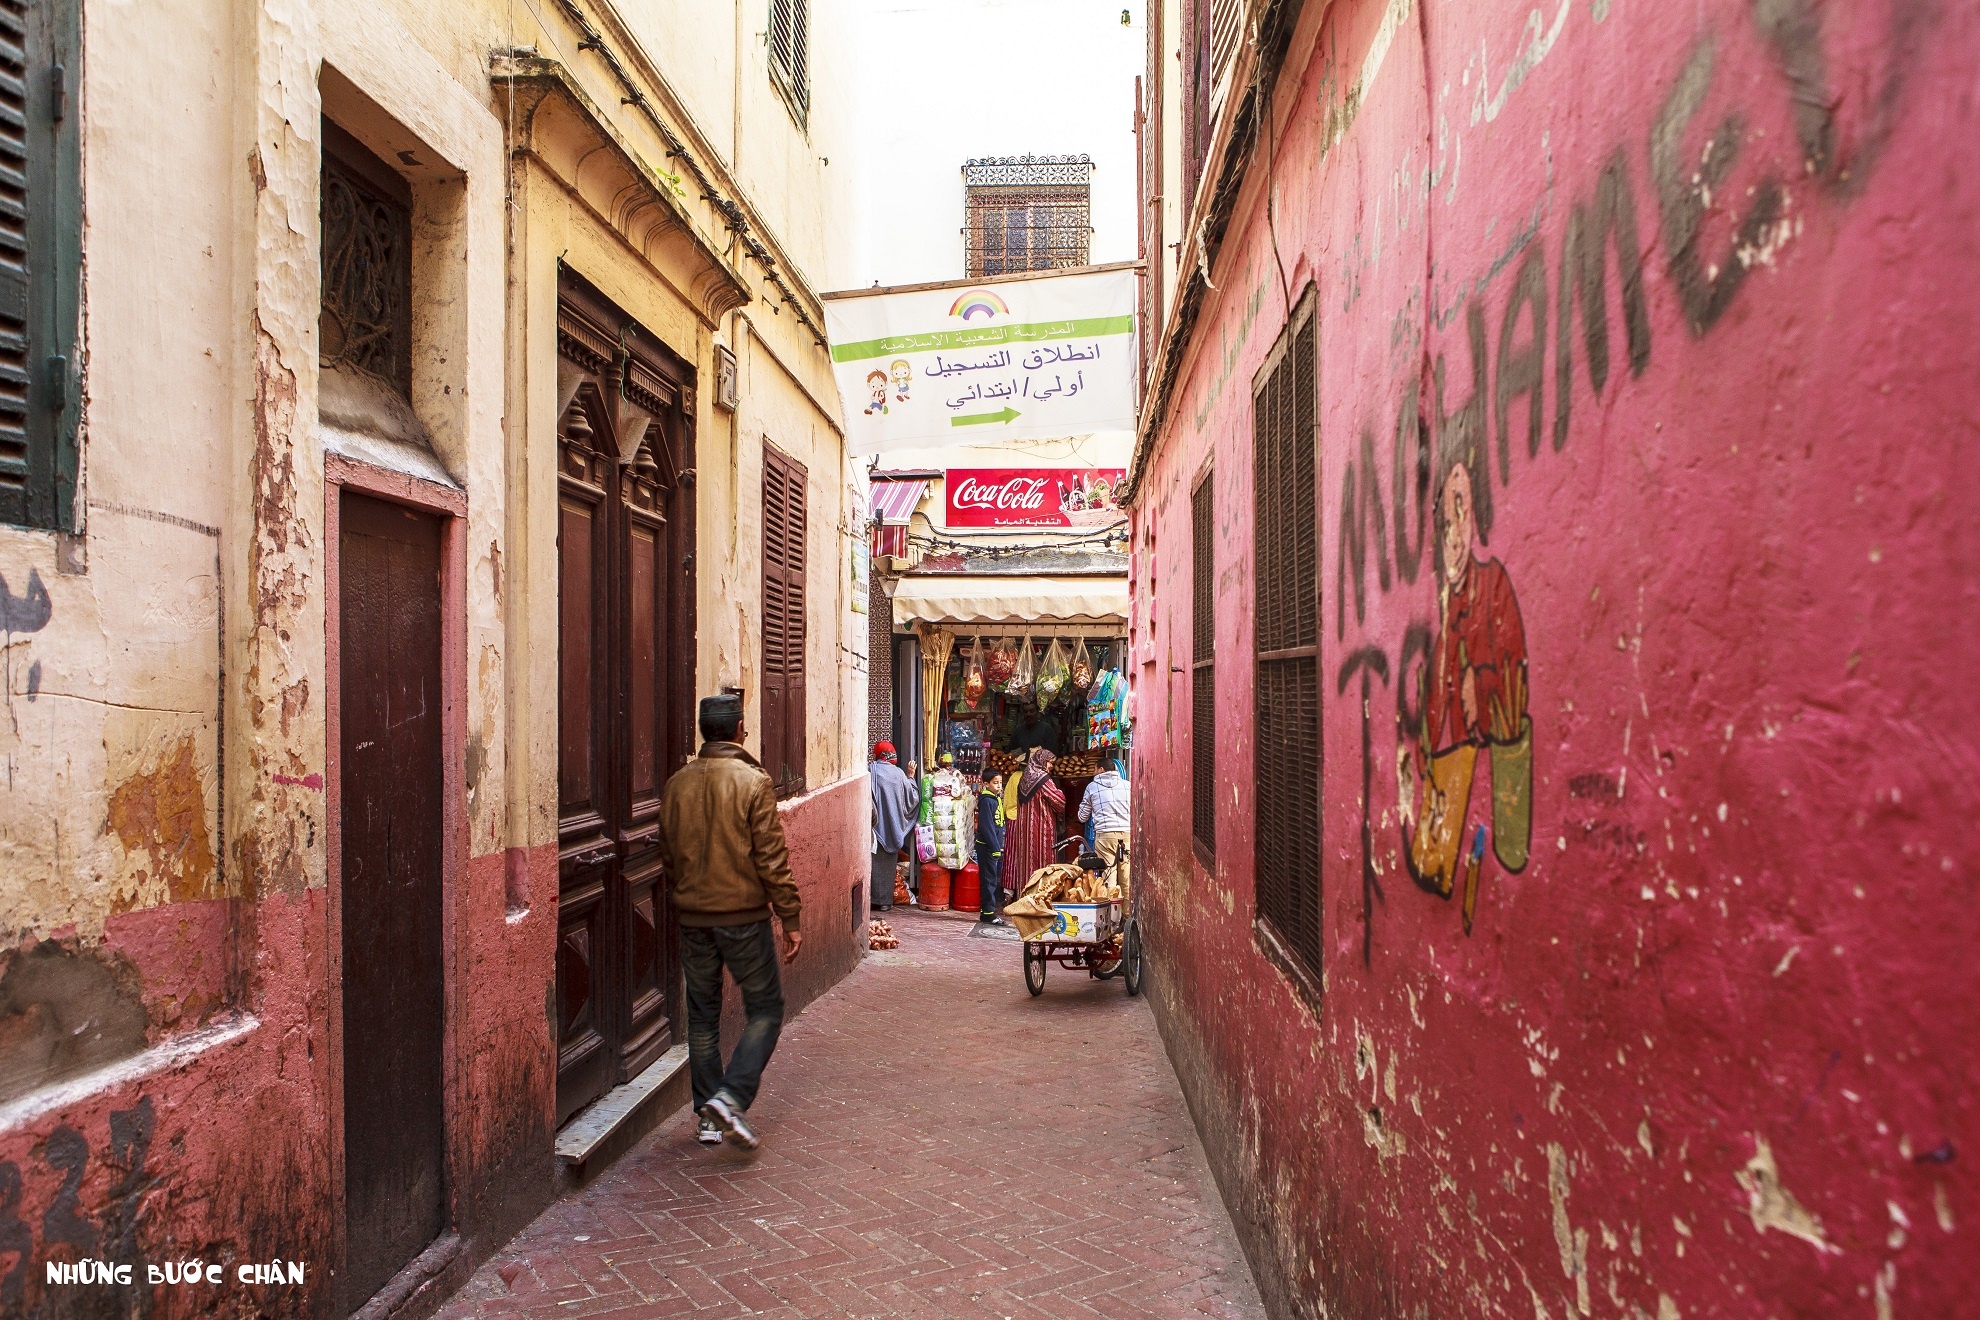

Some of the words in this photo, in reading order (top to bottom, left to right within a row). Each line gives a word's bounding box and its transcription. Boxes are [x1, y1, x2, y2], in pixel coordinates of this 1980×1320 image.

[880, 333, 949, 350] الإسلامية
[955, 328, 1008, 346] الشعبية
[1014, 322, 1075, 340] المدرسة
[925, 350, 1011, 378] التسجيل
[1022, 343, 1101, 370] انطلاق
[953, 477, 1051, 510] Coca-Cola
